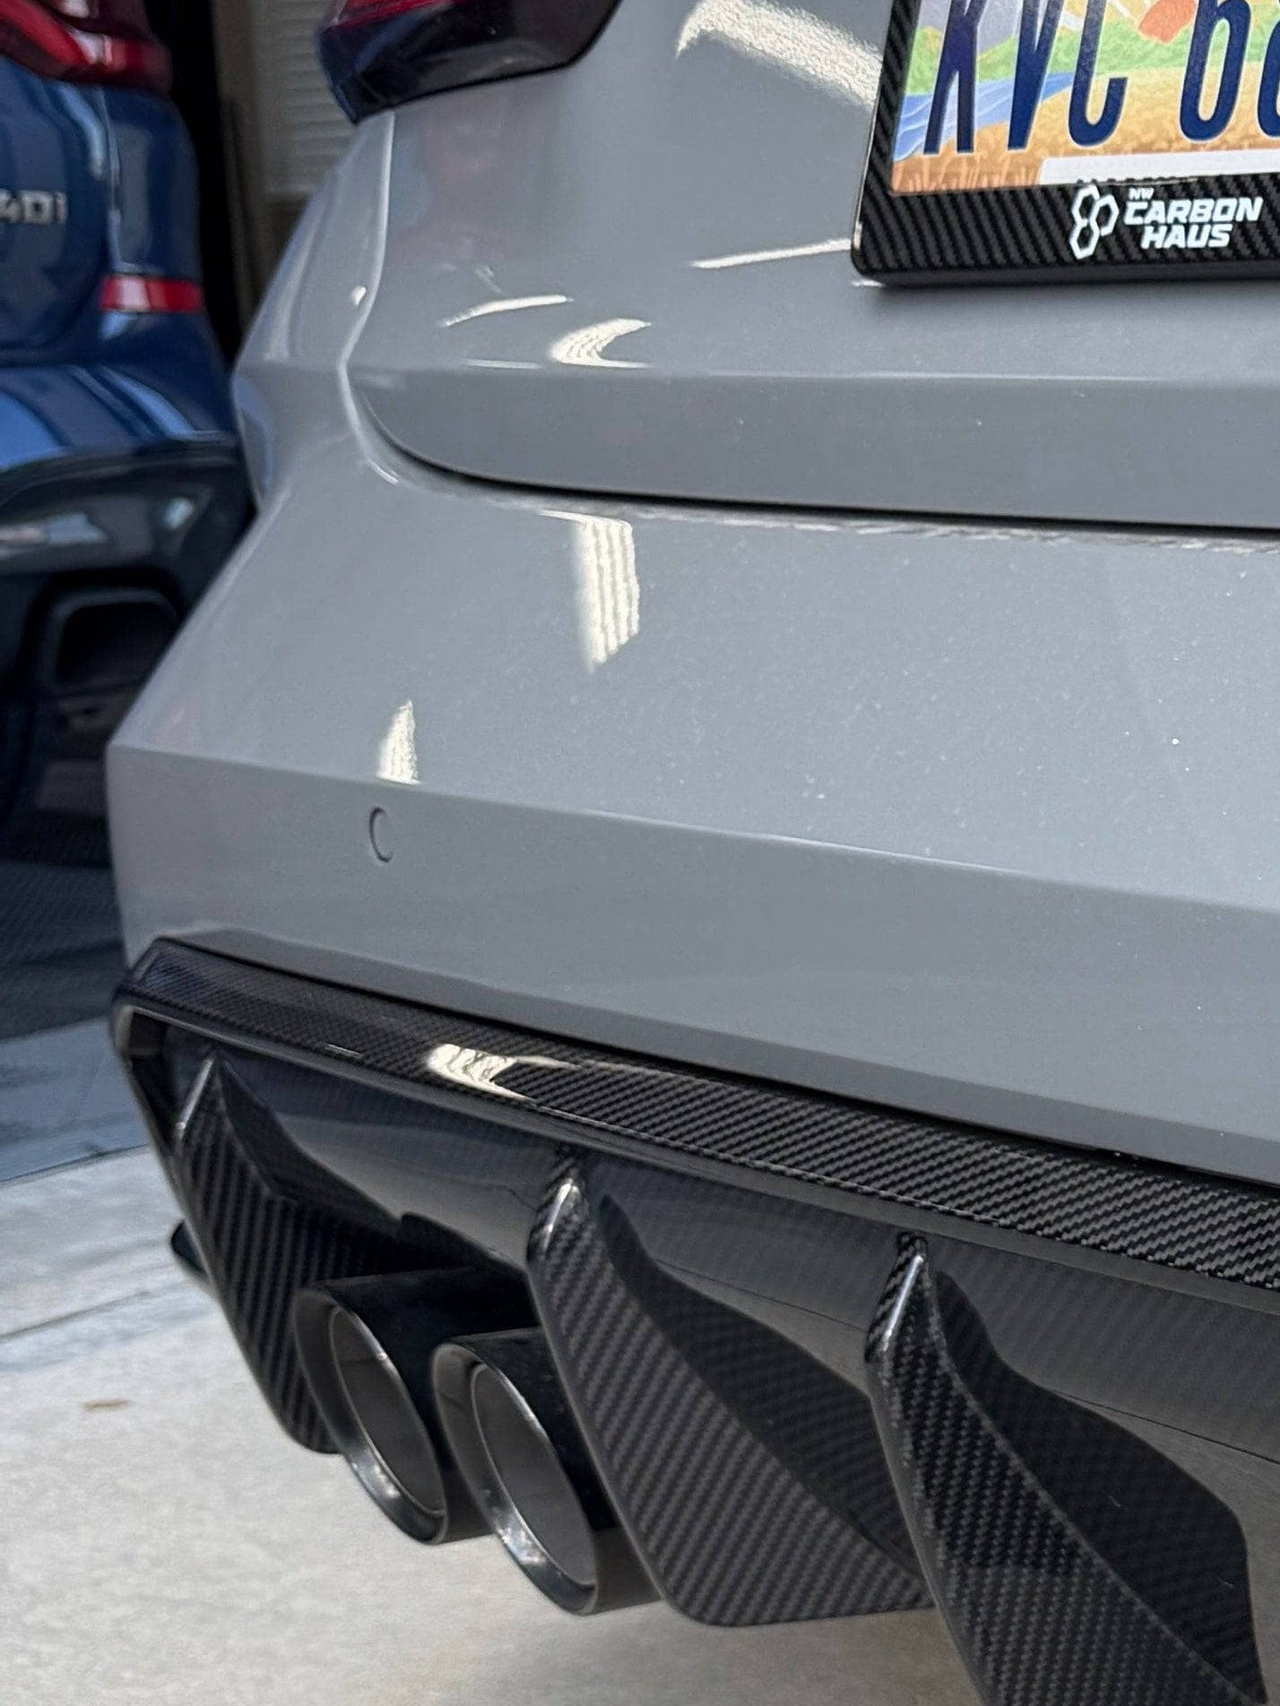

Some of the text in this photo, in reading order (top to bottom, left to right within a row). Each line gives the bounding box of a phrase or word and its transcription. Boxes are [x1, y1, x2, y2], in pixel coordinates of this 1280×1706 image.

[1129, 187, 1155, 200] NW
[1123, 196, 1264, 226] CARBON
[1140, 223, 1234, 250] HAUS
